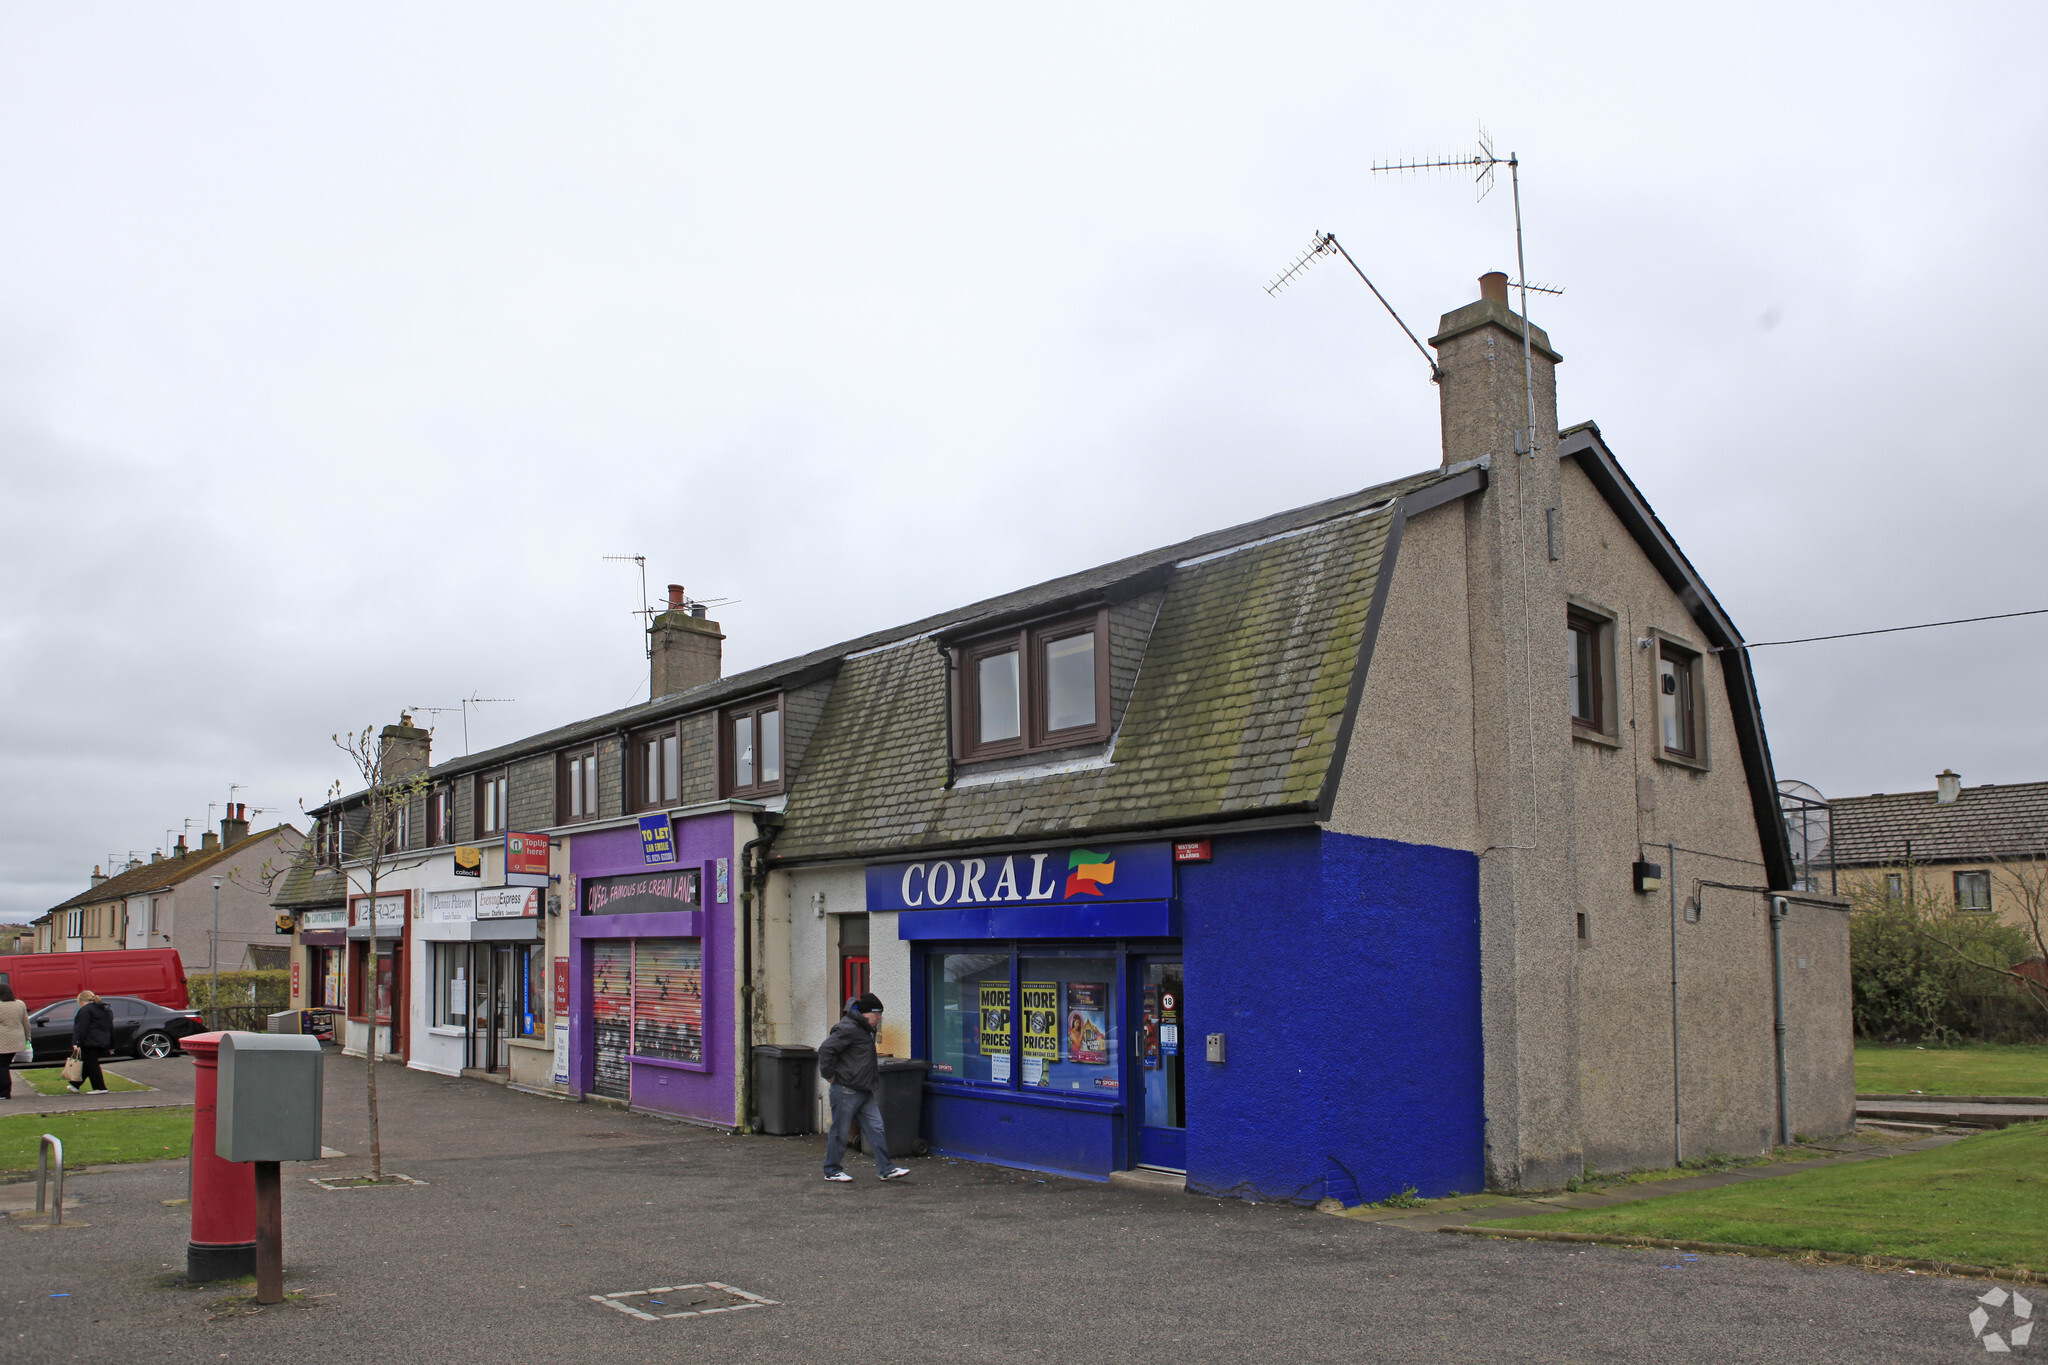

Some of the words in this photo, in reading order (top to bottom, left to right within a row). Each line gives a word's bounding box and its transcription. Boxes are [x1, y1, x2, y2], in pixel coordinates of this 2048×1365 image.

[641, 829, 652, 842] TO
[655, 826, 669, 840] LET
[525, 838, 547, 848] TopUp
[526, 848, 546, 856] here!
[901, 853, 1056, 907] CORAL
[609, 882, 636, 903] FAMOUS
[637, 879, 648, 896] ICE
[648, 877, 673, 898] CREAM
[434, 895, 450, 910] Dennis
[981, 990, 1010, 1007] MORE
[1023, 991, 1055, 1009] MORE
[1164, 997, 1173, 1006] 18
[981, 1033, 1010, 1047] PRICES
[1023, 1036, 1056, 1050] PRICES
